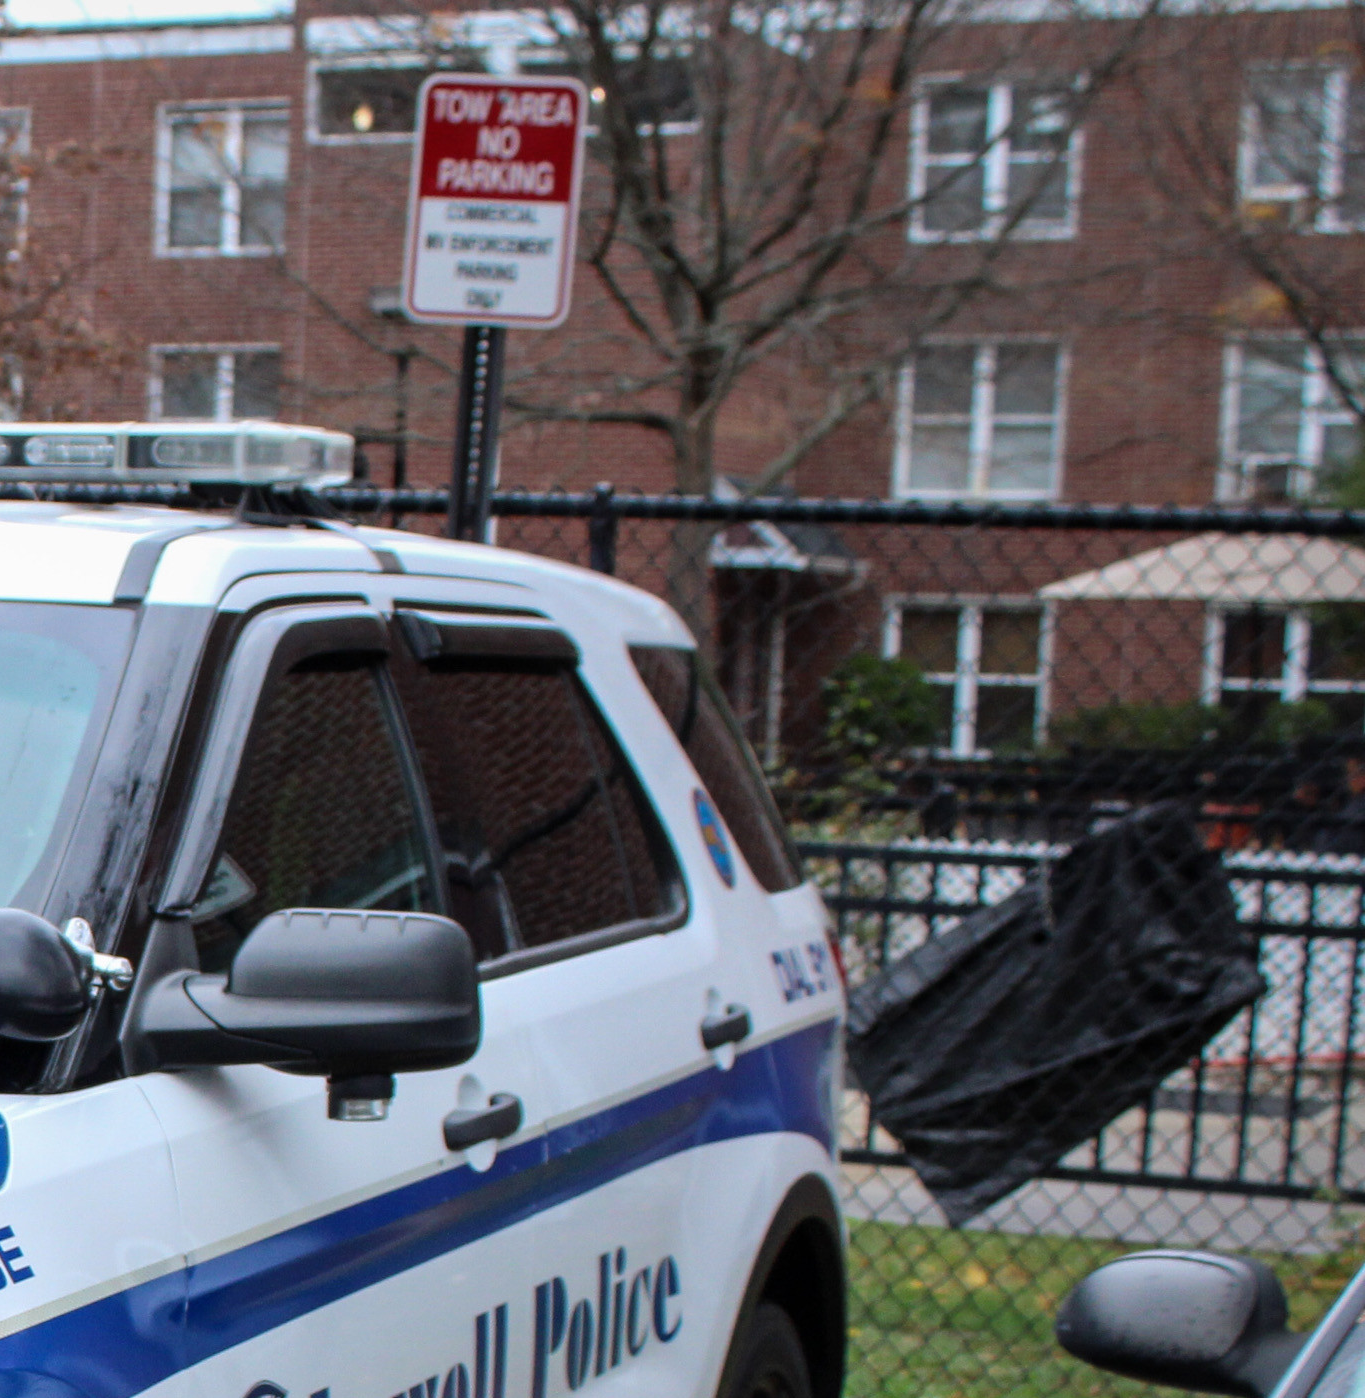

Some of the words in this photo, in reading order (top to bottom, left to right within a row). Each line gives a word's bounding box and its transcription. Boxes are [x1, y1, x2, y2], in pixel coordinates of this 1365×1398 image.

[431, 89, 495, 124] TOW
[498, 91, 573, 126] AREA
[476, 125, 521, 160] NO
[436, 157, 556, 196] PARKING
